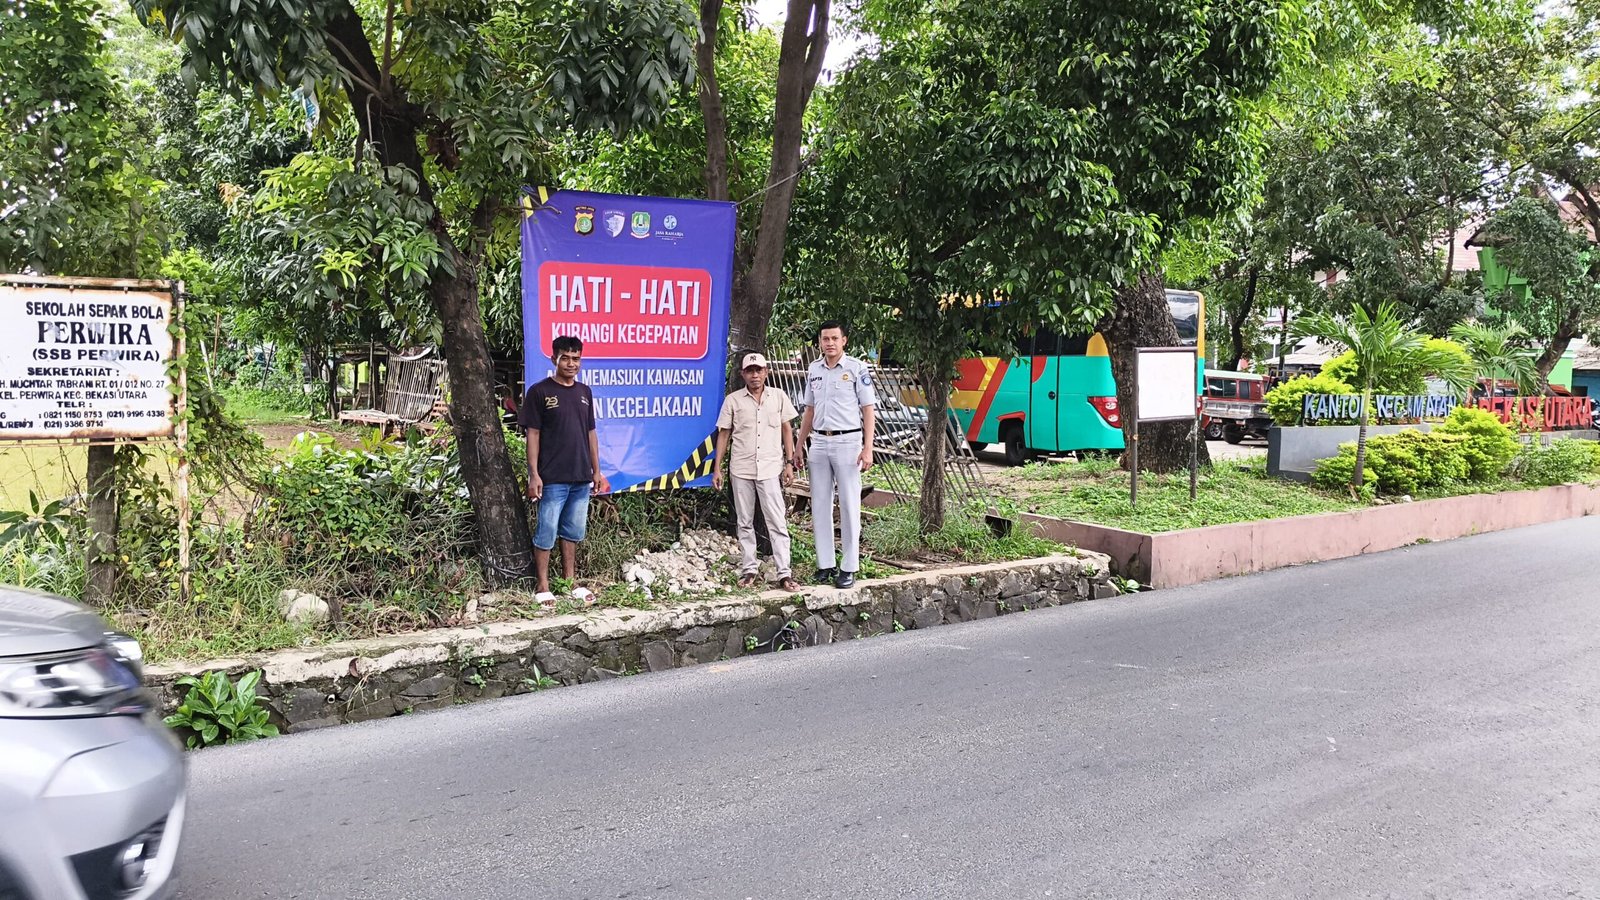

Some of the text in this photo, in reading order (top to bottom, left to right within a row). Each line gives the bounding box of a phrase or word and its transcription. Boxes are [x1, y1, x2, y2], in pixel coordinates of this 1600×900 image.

[550, 274, 612, 313] HATI
[639, 278, 701, 316] HATI
[26, 301, 164, 320] SEKOLAH SEPAK BOLA
[37, 320, 152, 345] PERWIRA
[551, 322, 699, 345] KURANGI KECEPATAN
[32, 348, 160, 362] (SSB PERWIRA)
[27, 367, 113, 376] SEKRETARIAT
[581, 368, 644, 386] MEMASUKI
[647, 369, 705, 386] KAWASAN
[10, 379, 53, 389] MUCHTAR
[56, 379, 94, 389] TABRANI
[140, 380, 154, 389] NO.
[156, 380, 165, 389] 27
[20, 390, 62, 400] PERWIRA
[63, 390, 84, 400] KEC.
[85, 390, 117, 400] BEKASI
[118, 390, 148, 400] UTARA
[43, 411, 63, 419] 0821
[64, 411, 82, 419] 1150
[83, 410, 103, 418] 8753
[106, 410, 125, 419] (021)
[126, 410, 144, 418] 9196
[146, 410, 165, 418] 4338
[606, 396, 702, 418] KECELAKAAN
[1303, 394, 1366, 419] KANTO
[1376, 394, 1457, 418] KECAMATAN
[1544, 396, 1593, 428] UTARA
[43, 420, 63, 430] (021)
[64, 420, 84, 428] 9386
